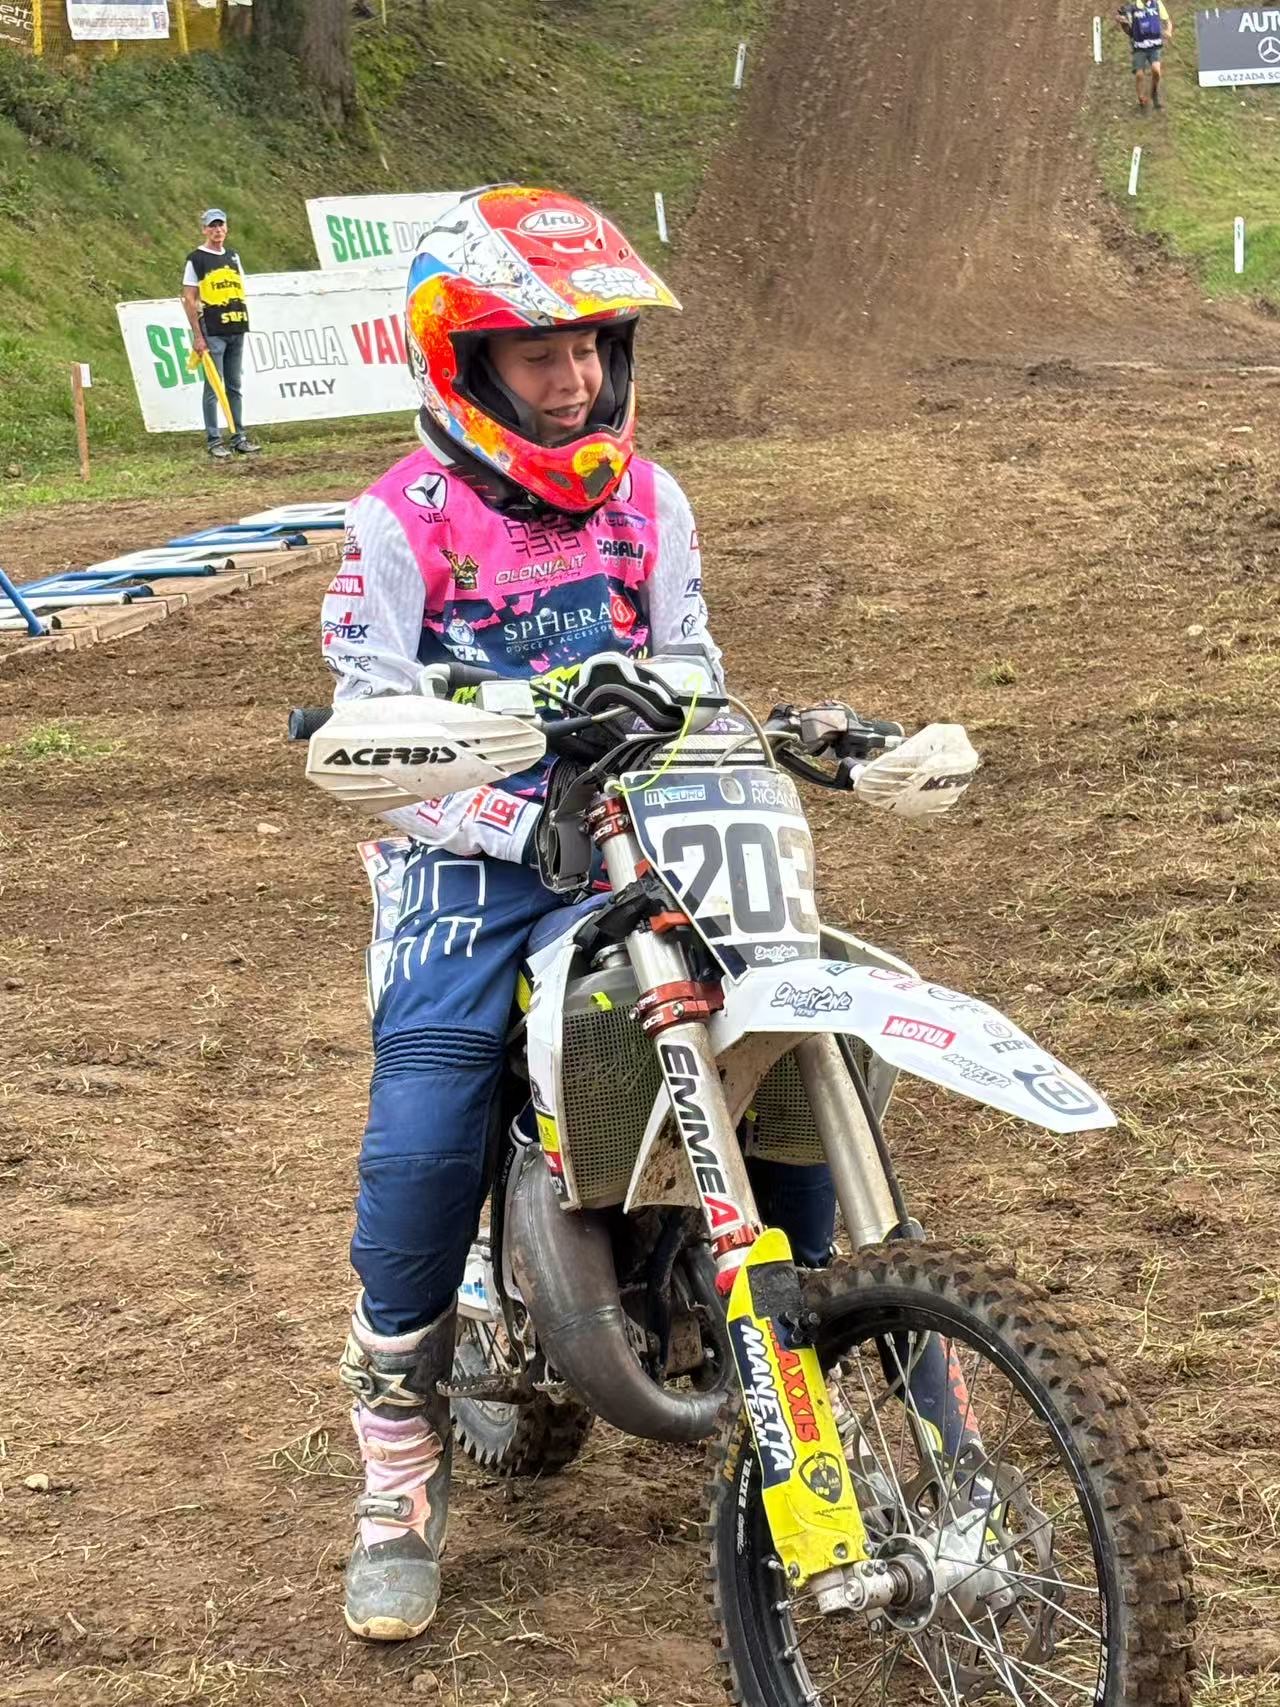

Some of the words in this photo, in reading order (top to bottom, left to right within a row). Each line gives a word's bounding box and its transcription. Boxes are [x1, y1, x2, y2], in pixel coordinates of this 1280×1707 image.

[1239, 11, 1280, 32] AUT
[1218, 74, 1265, 82] GAZZADA
[326, 214, 394, 263] SELLE
[522, 213, 582, 230] Arai
[146, 324, 206, 389] SE
[245, 326, 348, 373] DALLA
[279, 379, 336, 398] ITALY
[503, 602, 612, 642] SPHERA
[323, 746, 457, 766] ACERBIS
[662, 823, 819, 940] 203
[885, 1018, 950, 1048] MOTUL
[660, 1043, 740, 1230] EMMEA
[740, 1324, 798, 1471] MANETTA
[768, 1322, 821, 1443] AXXIS
[744, 1384, 770, 1447] TEAM
[738, 1457, 753, 1508] EXCEL
